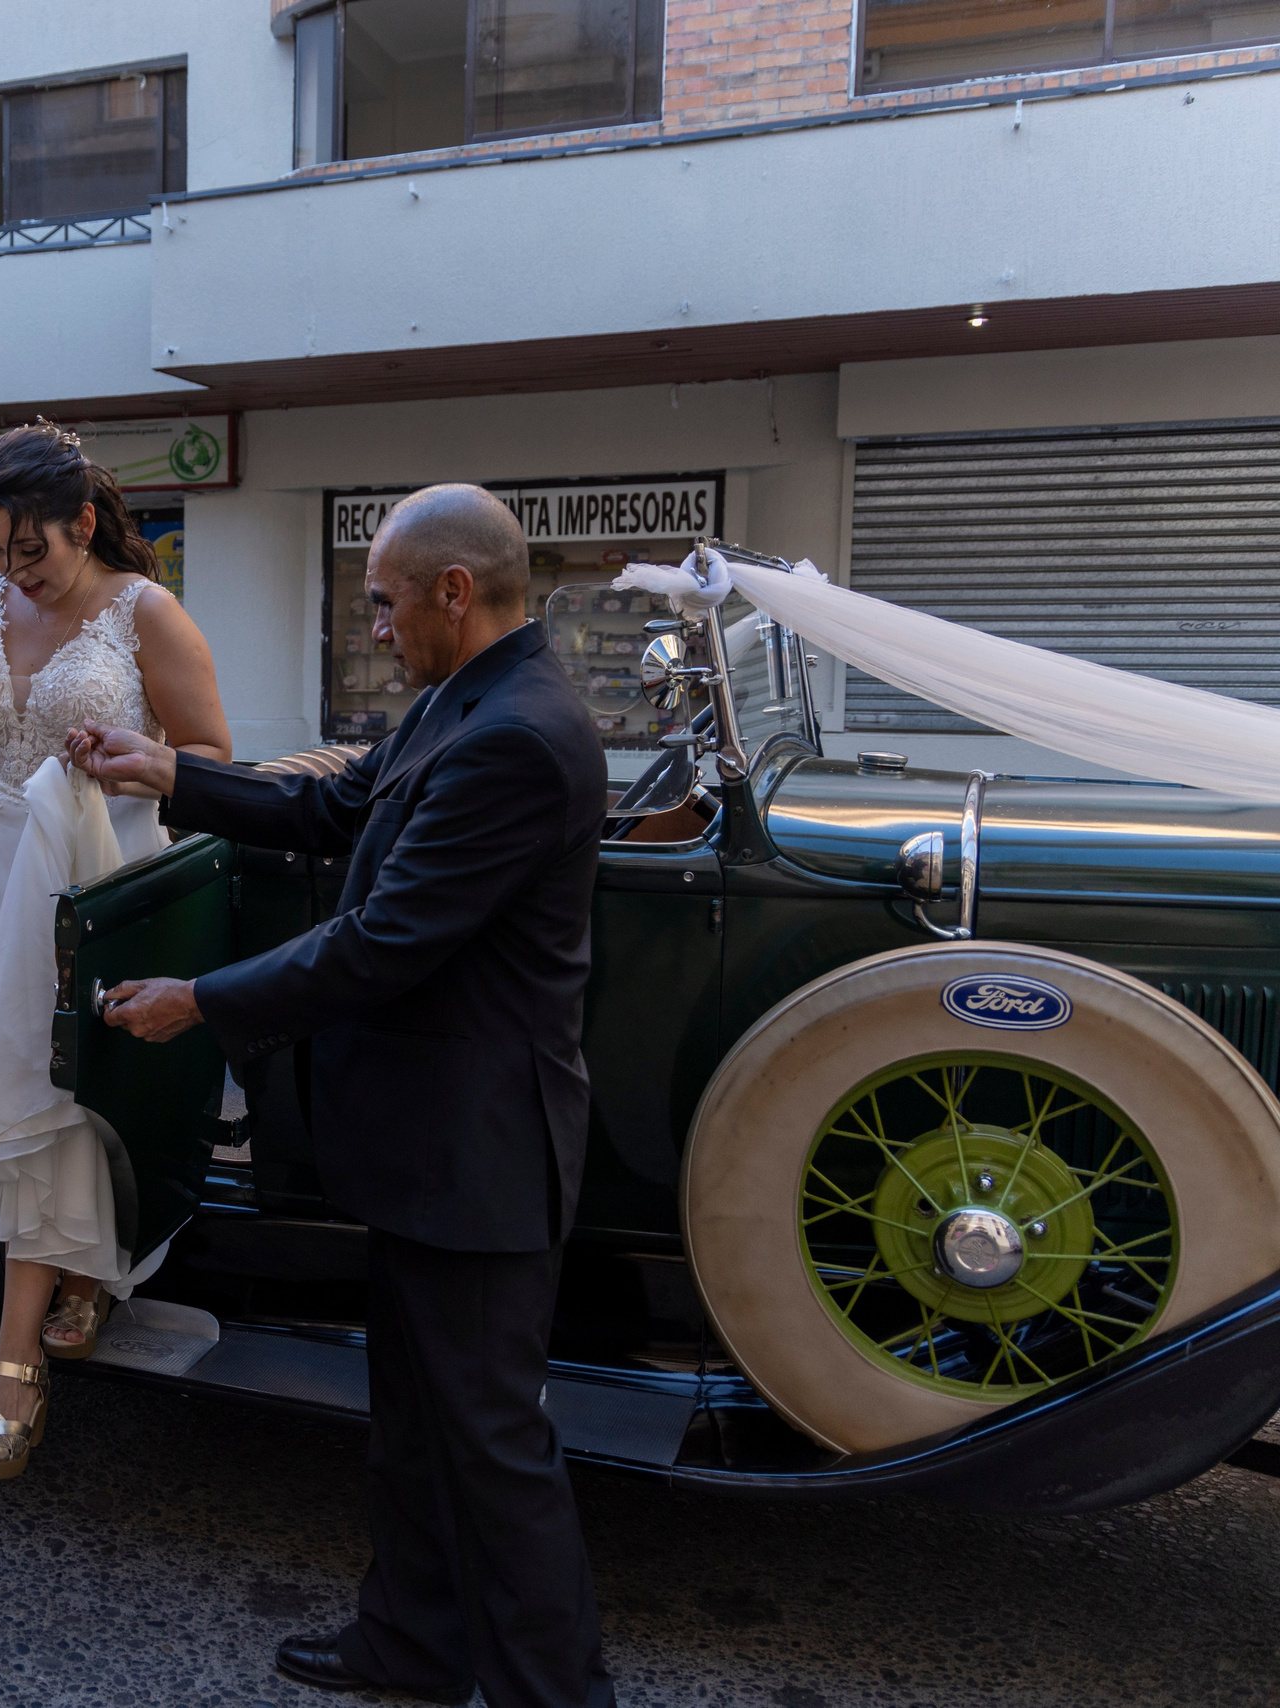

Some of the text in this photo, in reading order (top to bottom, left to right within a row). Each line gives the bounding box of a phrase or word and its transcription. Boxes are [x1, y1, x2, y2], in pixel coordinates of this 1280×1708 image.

[337, 489, 707, 542] RECA NTA IMPRESORAS
[966, 984, 1046, 1015] Ford
